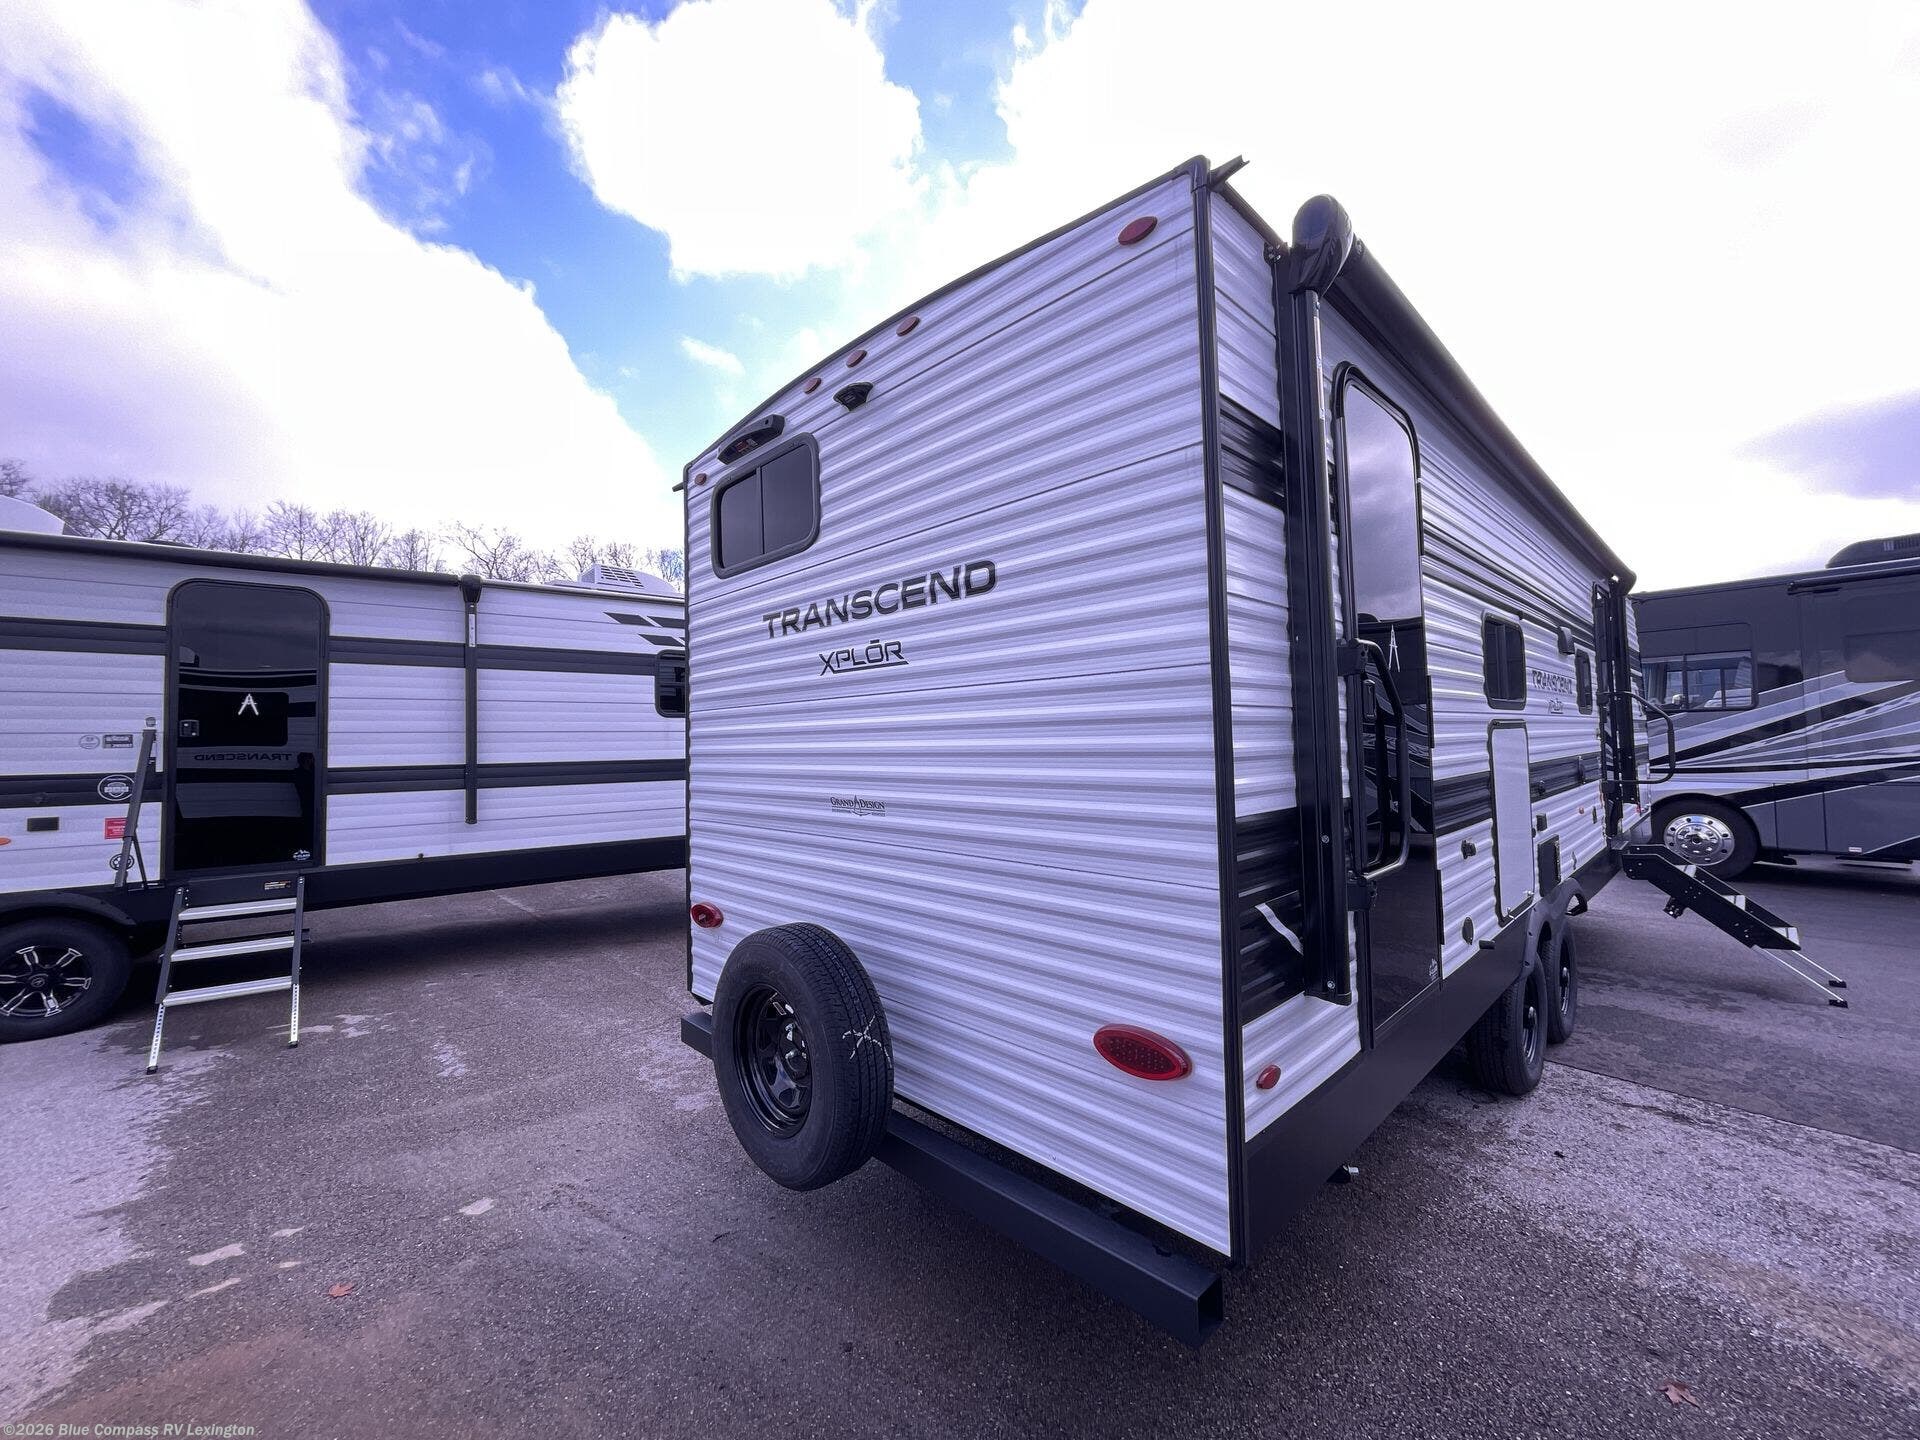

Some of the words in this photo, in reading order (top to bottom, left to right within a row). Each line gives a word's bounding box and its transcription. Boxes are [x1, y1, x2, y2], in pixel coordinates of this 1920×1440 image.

[763, 560, 996, 639] TRANSCEND
[830, 796, 854, 807] GRAND
[859, 799, 886, 810] DESIGN
